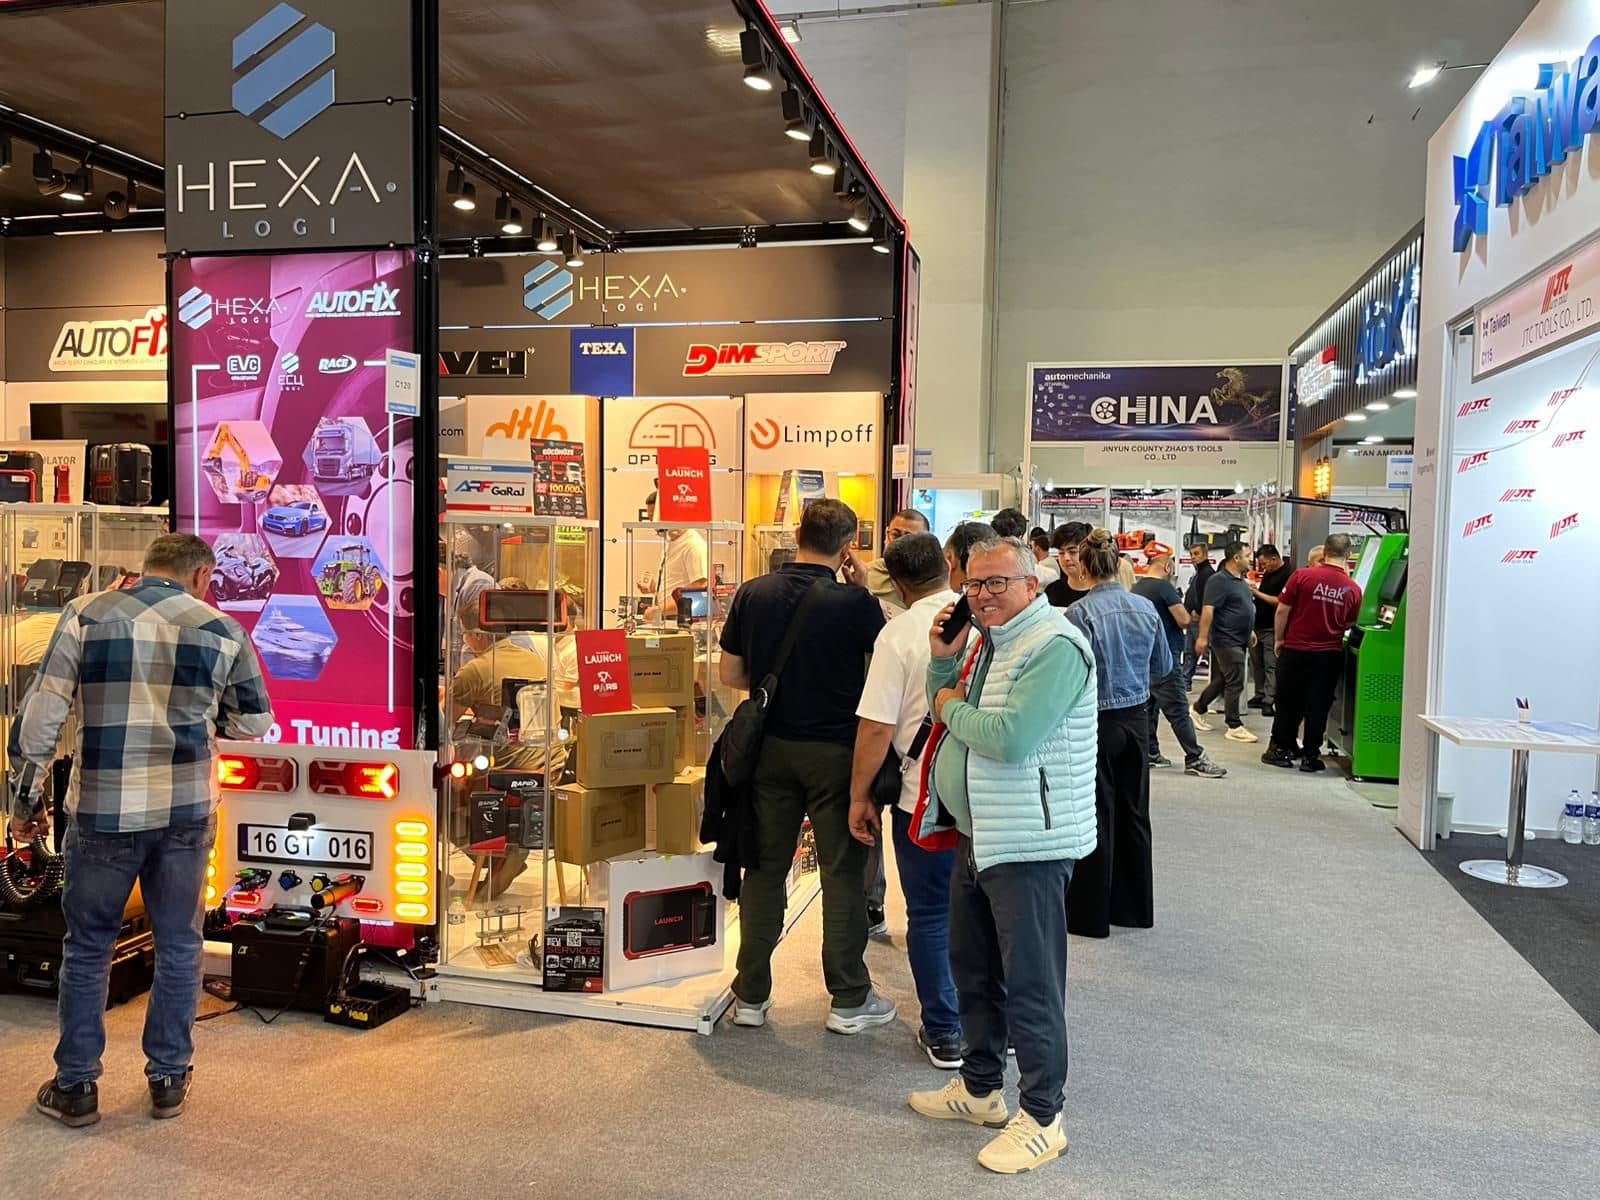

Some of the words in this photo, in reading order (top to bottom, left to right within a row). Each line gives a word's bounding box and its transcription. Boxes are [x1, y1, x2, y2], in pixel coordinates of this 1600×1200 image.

[177, 152, 381, 212] HEXA
[222, 217, 336, 239] LOGI
[579, 273, 680, 300] HEXA
[306, 281, 400, 313] AUTOFIX
[216, 298, 283, 315] HEXA
[602, 303, 658, 313] LOGI
[1489, 312, 1512, 336] Taiwan
[1534, 313, 1558, 341] TOOLS
[580, 342, 627, 355] TEXA
[229, 358, 259, 371] EVC
[395, 380, 412, 390] C120
[1044, 372, 1111, 381] automechanika
[1090, 395, 1218, 425] CHINA
[784, 424, 873, 448] Limpoff
[665, 469, 704, 478] LAUNCH
[1313, 583, 1344, 600] Atak
[584, 653, 622, 665] LAUNCH
[593, 682, 618, 693] PARS
[291, 719, 401, 750] Tuning
[253, 832, 277, 854] 16
[284, 834, 315, 856] GT
[329, 837, 367, 859] 016
[655, 914, 683, 926] LAUNCH
